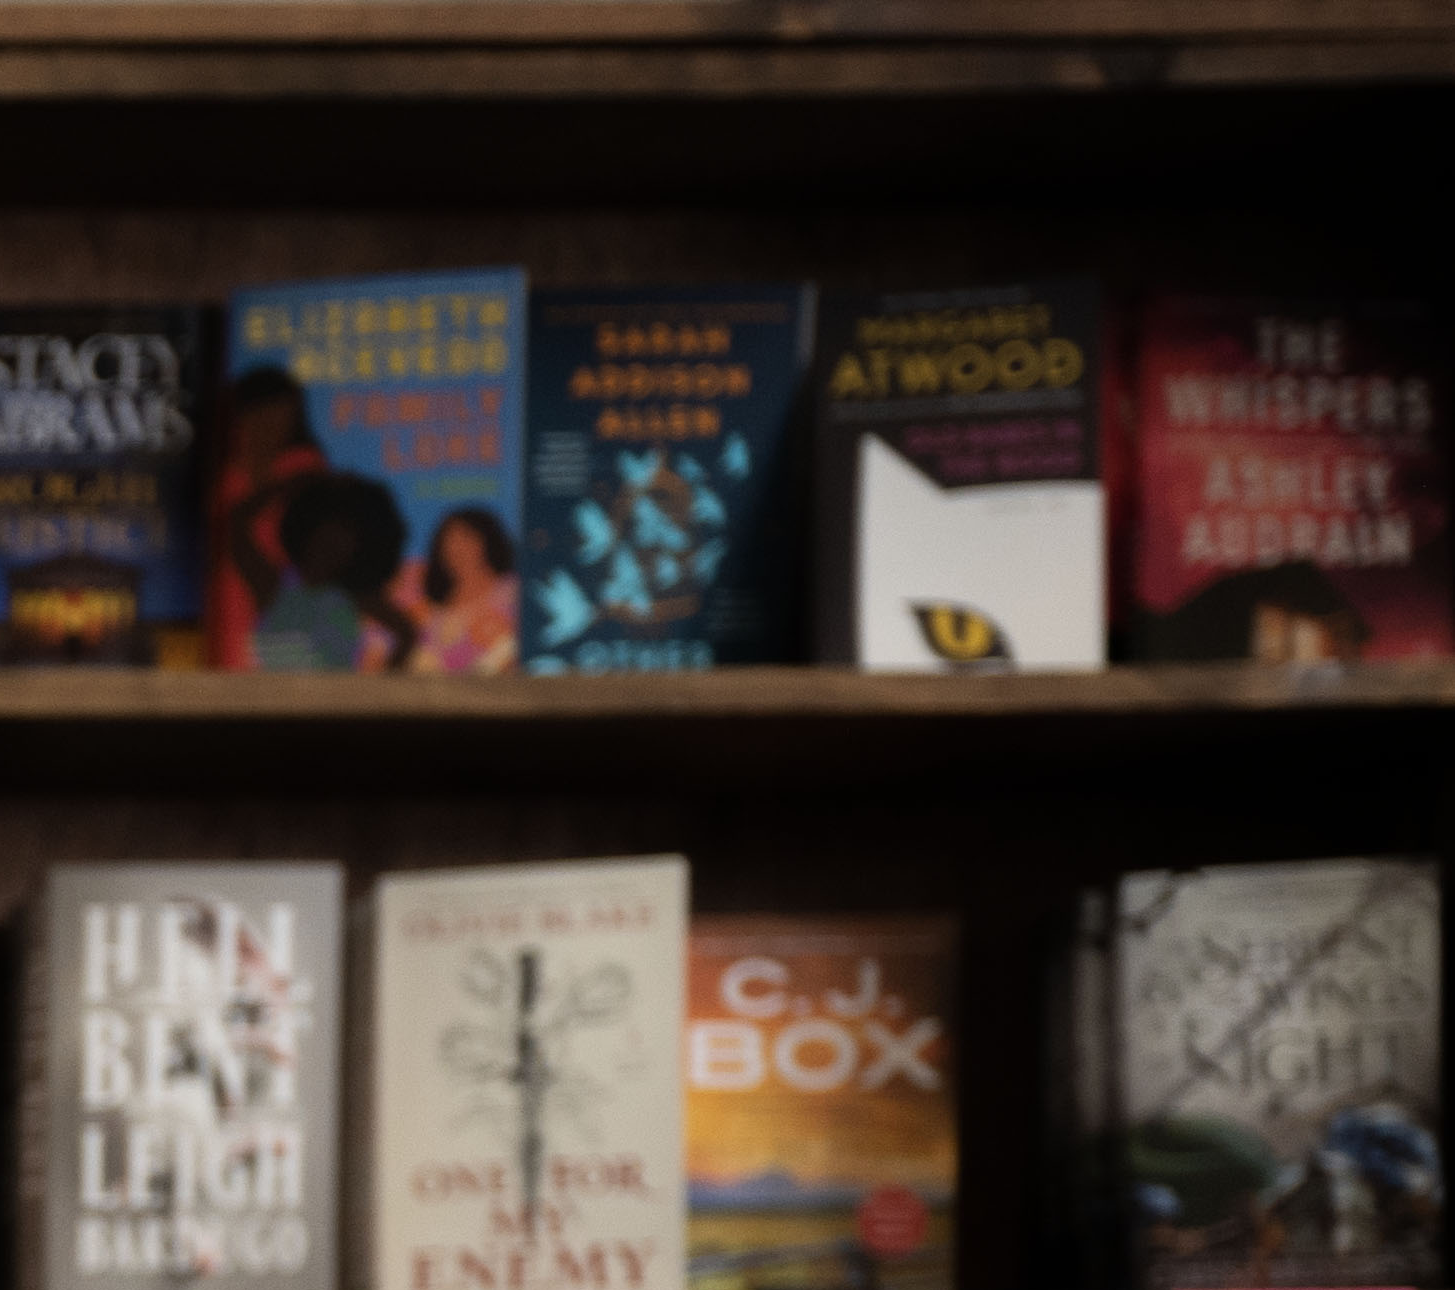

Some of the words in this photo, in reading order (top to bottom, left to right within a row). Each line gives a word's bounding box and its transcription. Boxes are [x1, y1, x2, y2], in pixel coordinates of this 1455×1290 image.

[246, 296, 508, 347] ELIZABETH
[855, 305, 1050, 345] MARGARET
[1257, 318, 1343, 365] THE
[292, 339, 508, 382] ACEVEDO
[569, 365, 751, 398] ADDISON
[830, 340, 1086, 396] ATWOOD
[596, 405, 722, 438] ALLEN
[1161, 373, 1431, 432] WHISPERS
[1201, 456, 1394, 509] ASHLEY
[1181, 514, 1413, 565] AUDRAIN
[721, 959, 902, 1017] C.J.
[690, 1021, 940, 1090] BOX
[81, 1123, 304, 1209] LEIGH
